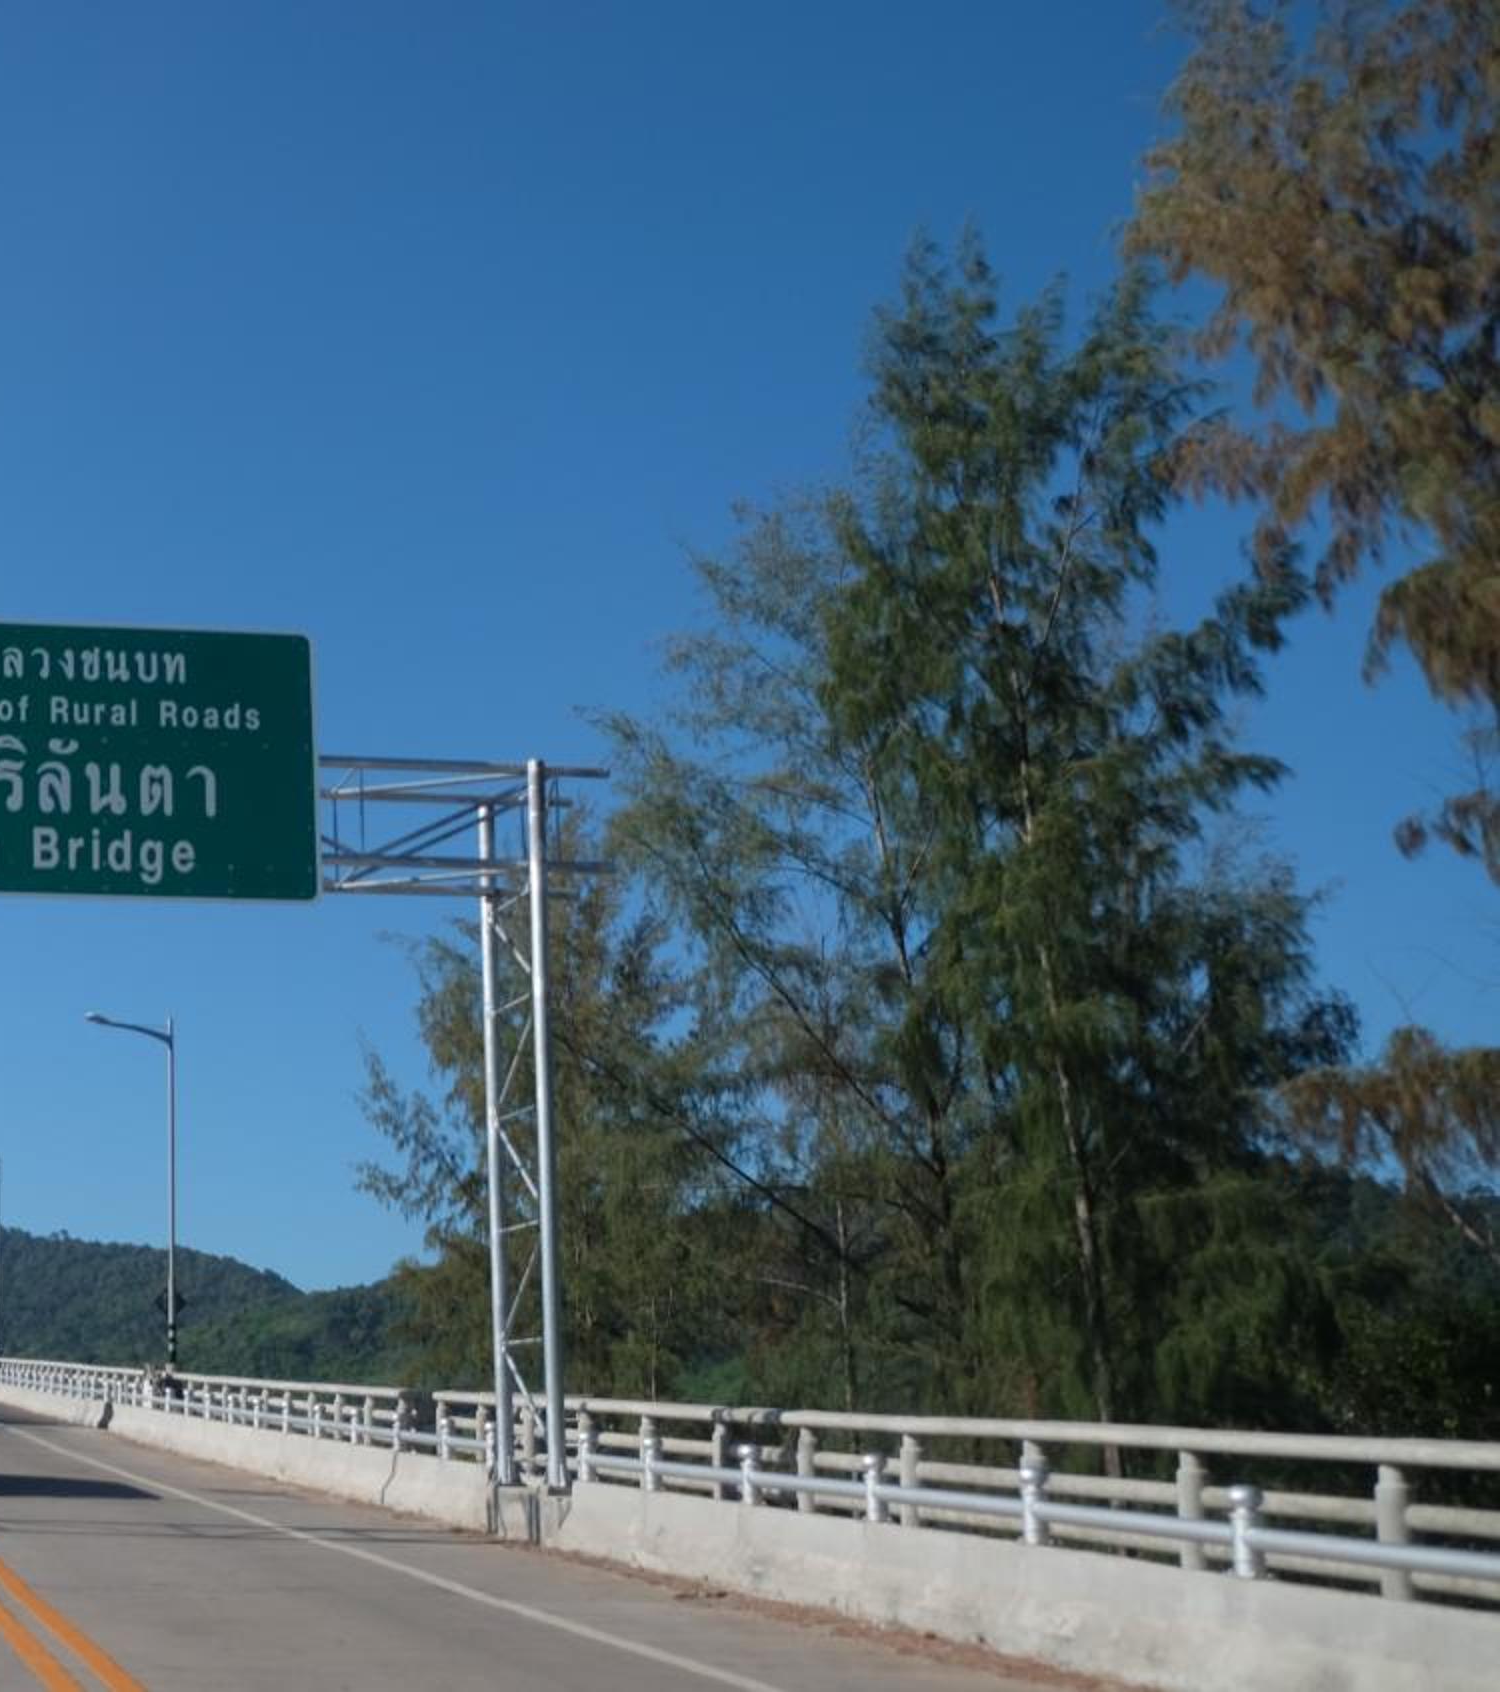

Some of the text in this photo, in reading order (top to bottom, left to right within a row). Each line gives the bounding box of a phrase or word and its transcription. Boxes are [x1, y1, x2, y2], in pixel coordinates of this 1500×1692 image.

[51, 697, 138, 726] Rural
[160, 701, 261, 731] Roads
[33, 826, 196, 884] Bridge
